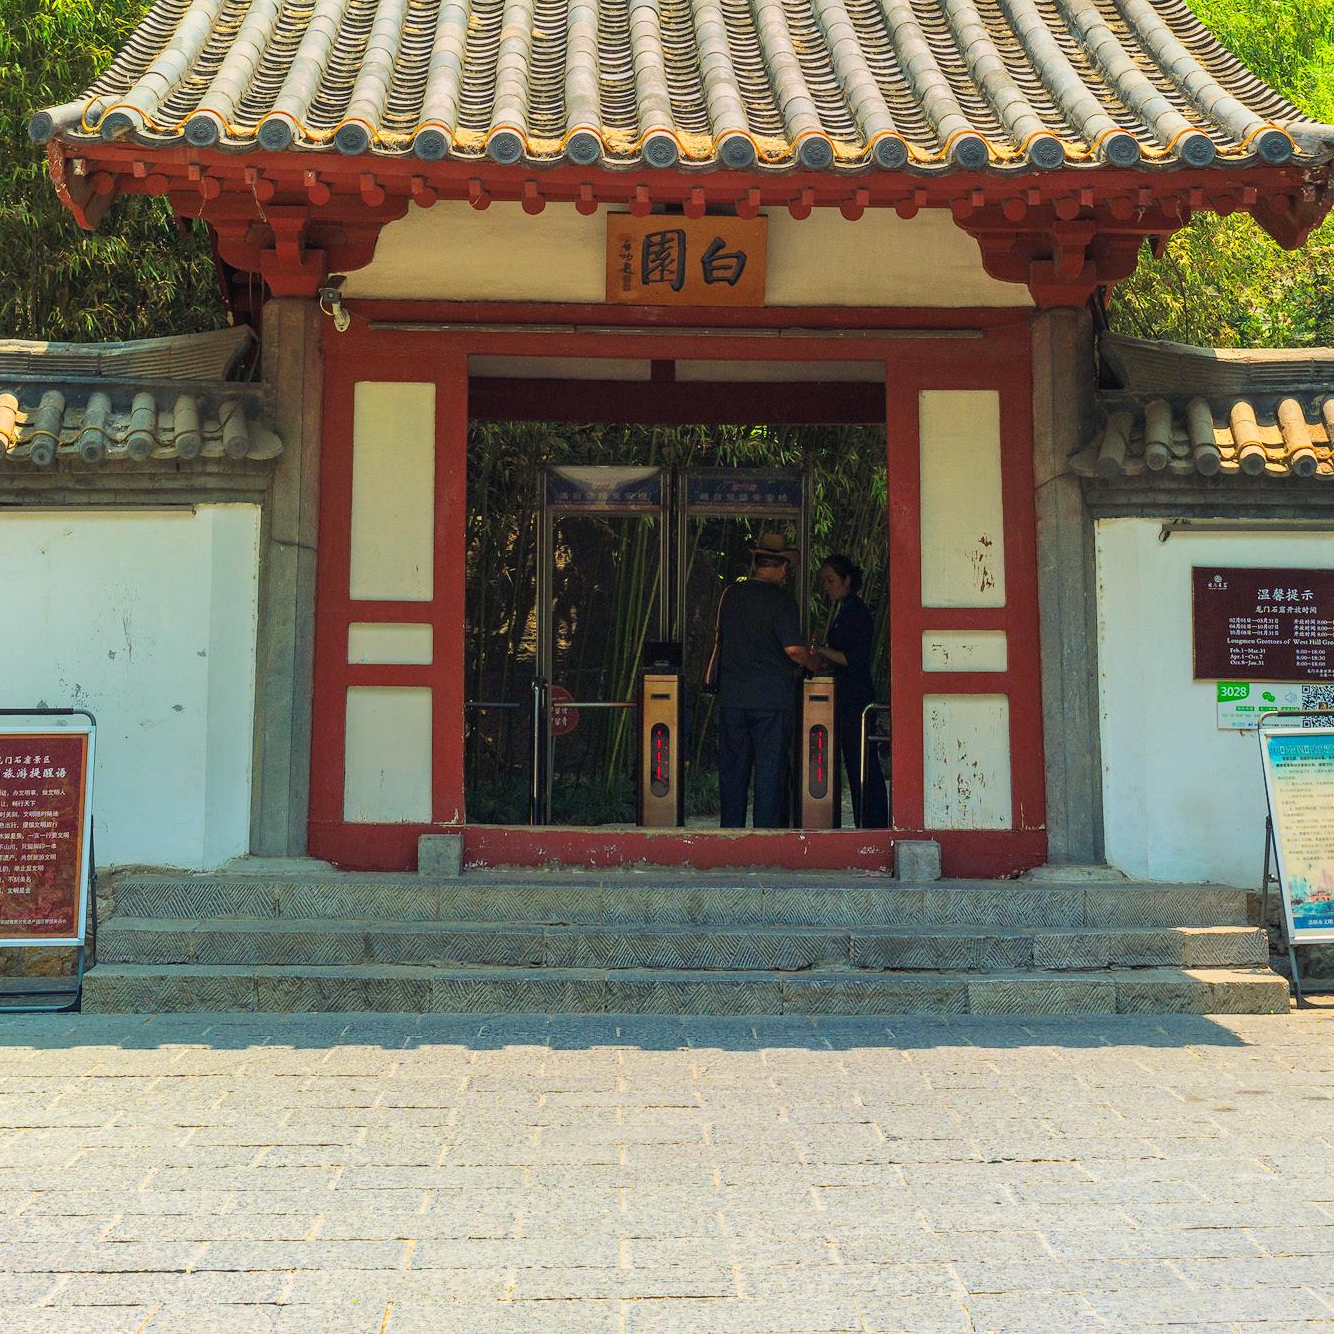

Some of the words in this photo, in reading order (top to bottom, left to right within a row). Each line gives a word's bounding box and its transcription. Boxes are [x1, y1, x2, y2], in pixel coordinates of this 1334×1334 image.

[1257, 587, 1314, 602] 温馨提示
[1255, 605, 1317, 614] 龙门石窟开放时间
[1227, 637, 1255, 645] Longmen
[1220, 686, 1247, 697] 3028
